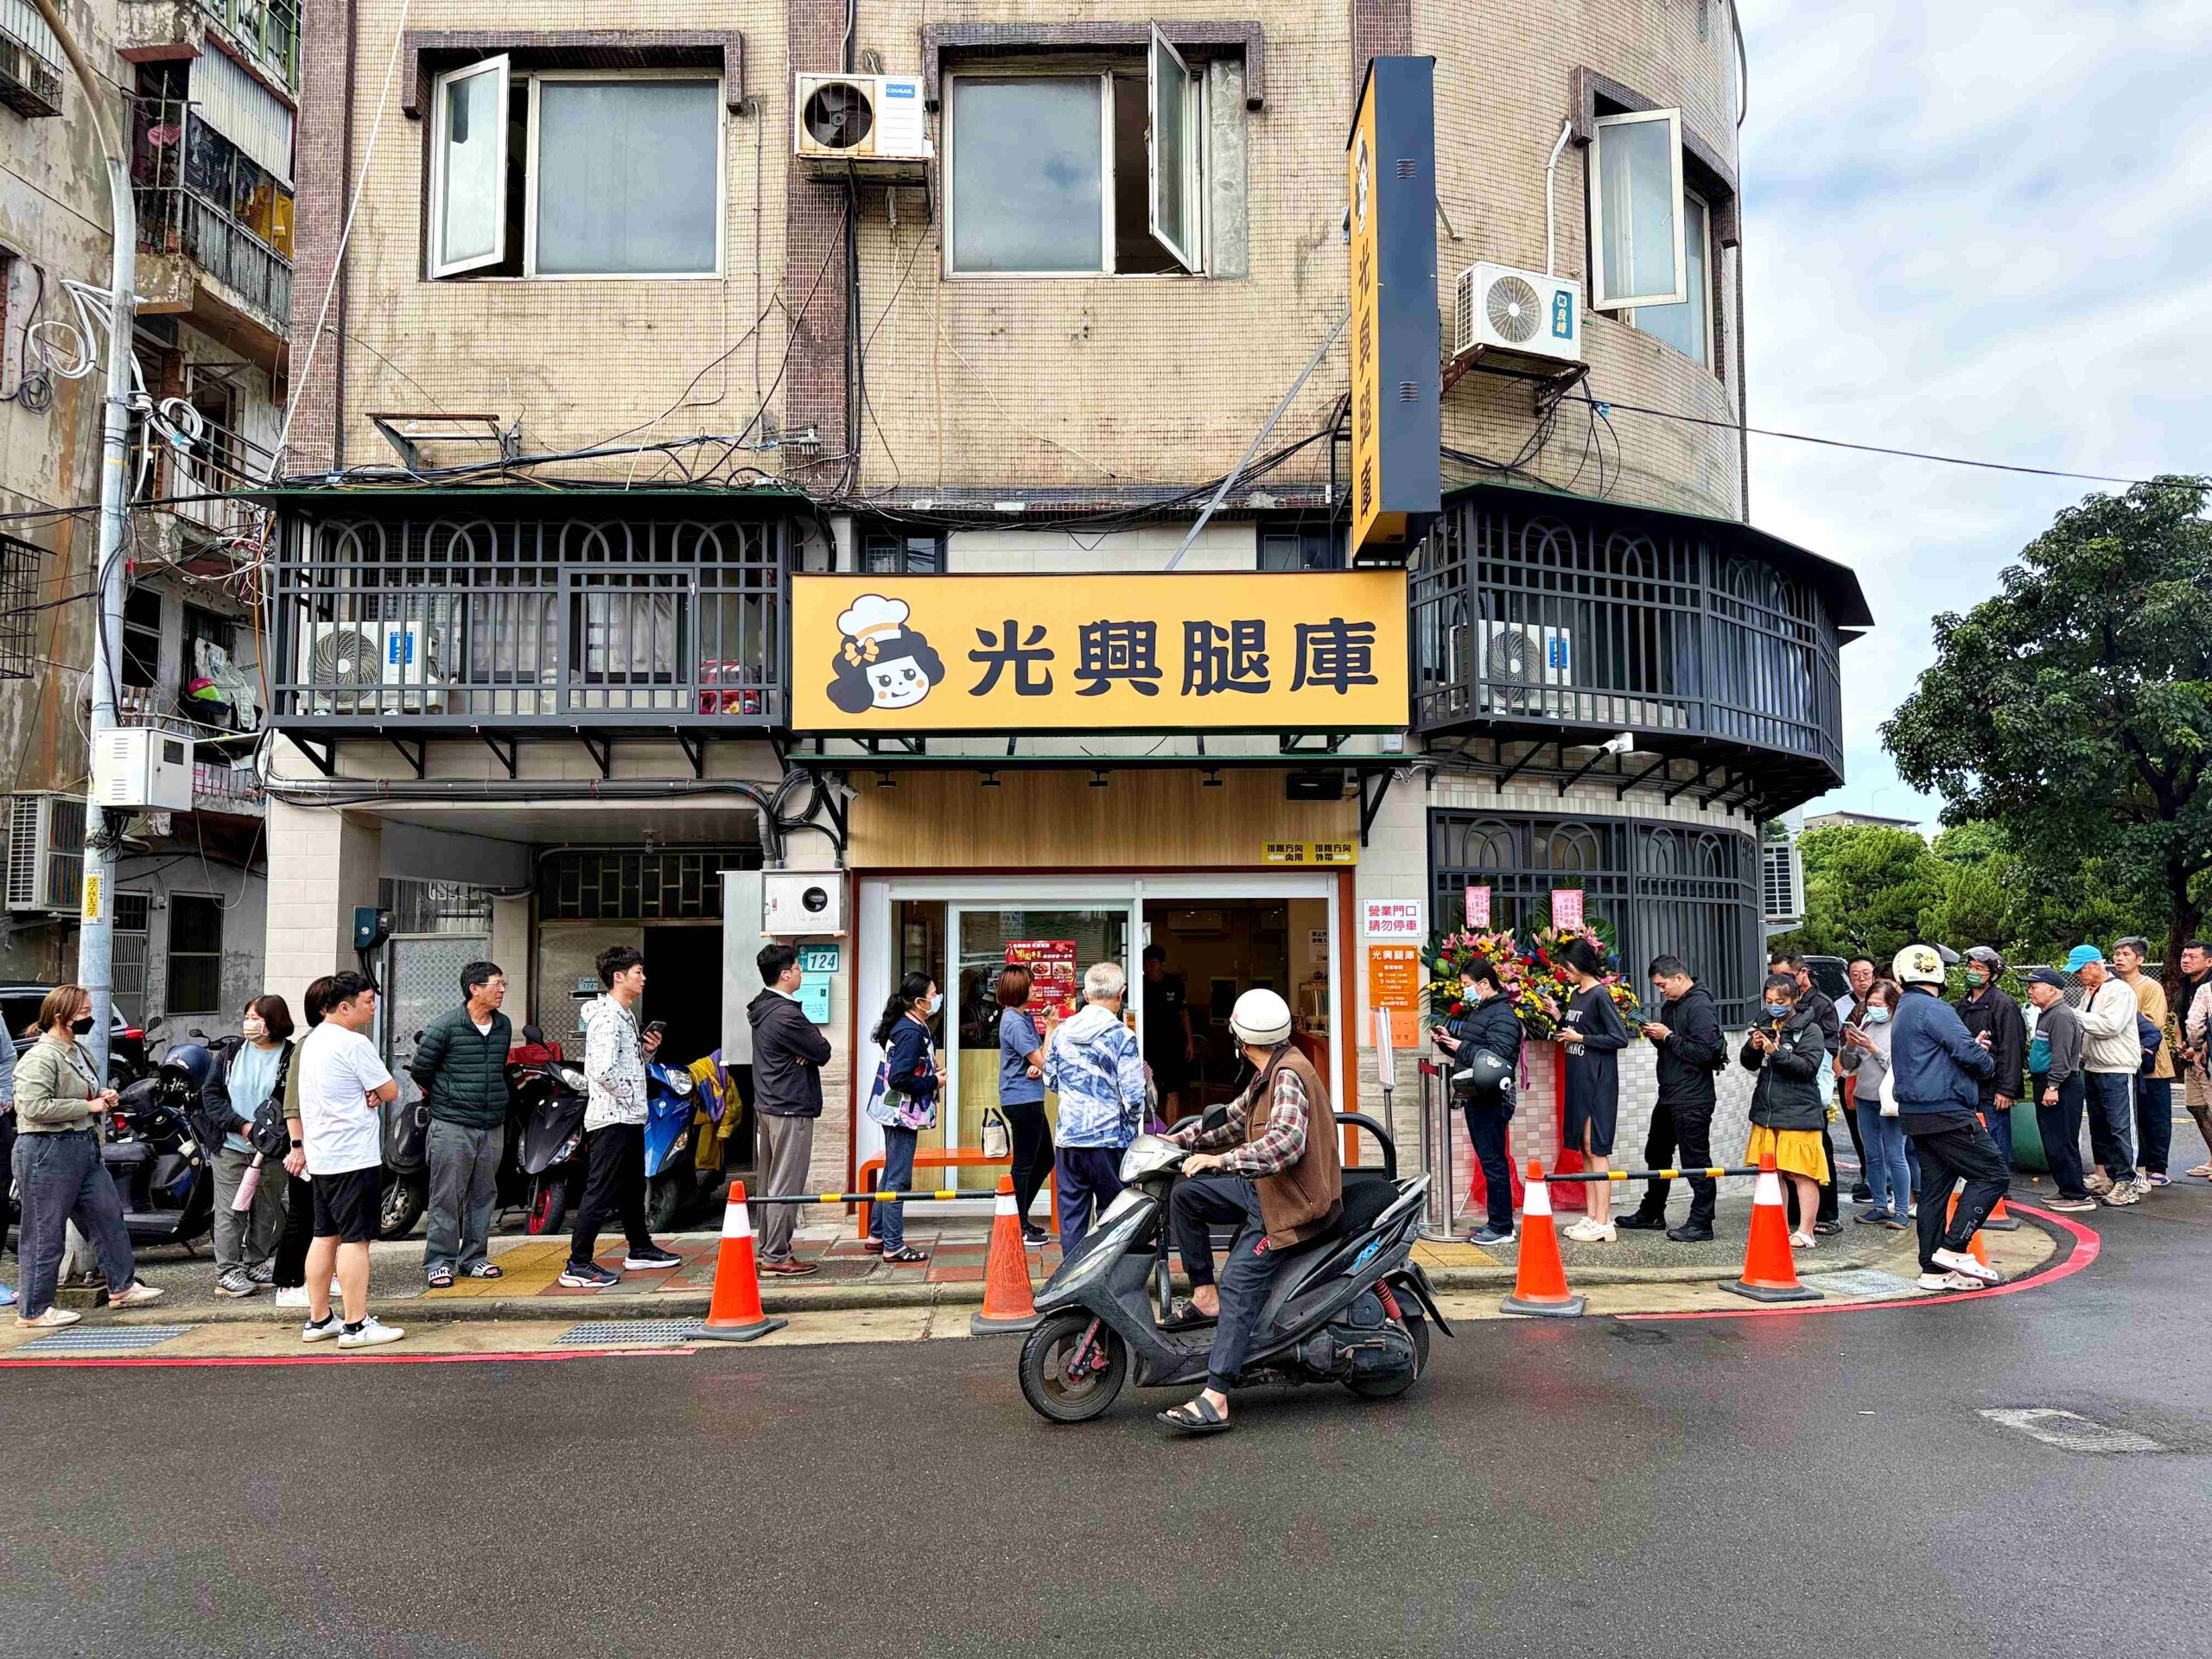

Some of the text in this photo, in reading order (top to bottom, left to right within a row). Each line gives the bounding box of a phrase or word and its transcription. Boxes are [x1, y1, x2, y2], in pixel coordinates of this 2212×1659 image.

[1358, 238, 1372, 524] 光興腿庫
[967, 618, 1379, 697] 光興腿庫
[1267, 843, 1351, 853] 排隊方向 排隊方向
[1285, 853, 1303, 861] 內用
[1315, 853, 1333, 861] 外帶
[1368, 905, 1417, 917] 營業門口
[1368, 919, 1417, 931] 請勿停車
[810, 954, 836, 969] 124
